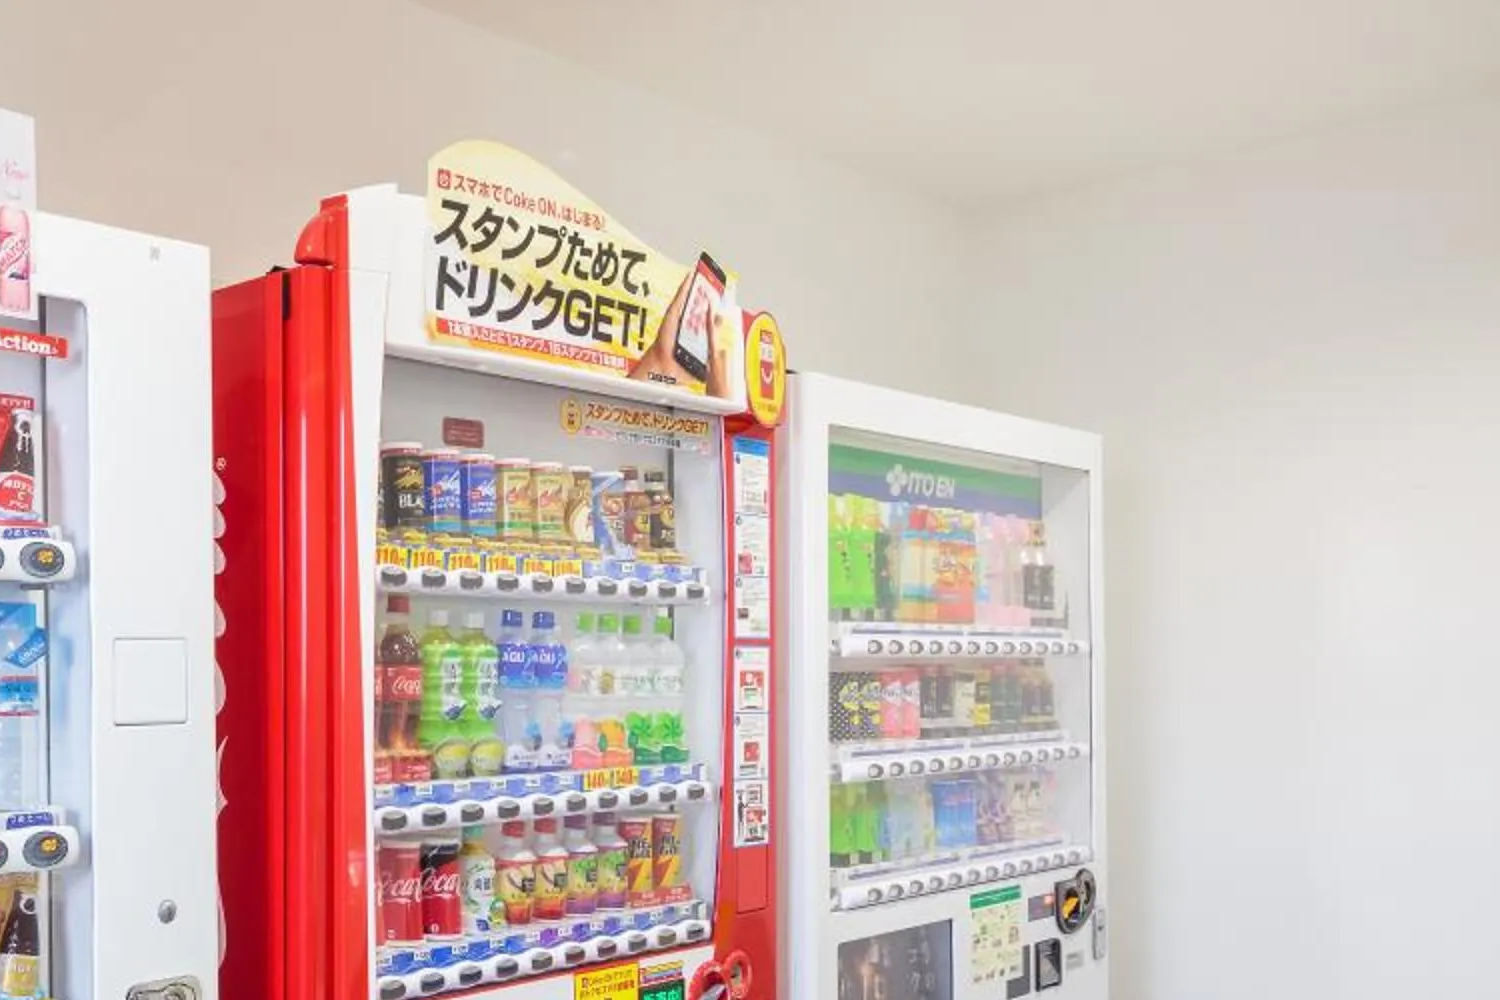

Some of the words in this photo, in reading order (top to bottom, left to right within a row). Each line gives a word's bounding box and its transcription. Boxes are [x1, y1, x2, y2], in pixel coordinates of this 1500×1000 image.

[434, 198, 651, 297] スタンプためて、
[435, 256, 647, 351] ドリンクGET!
